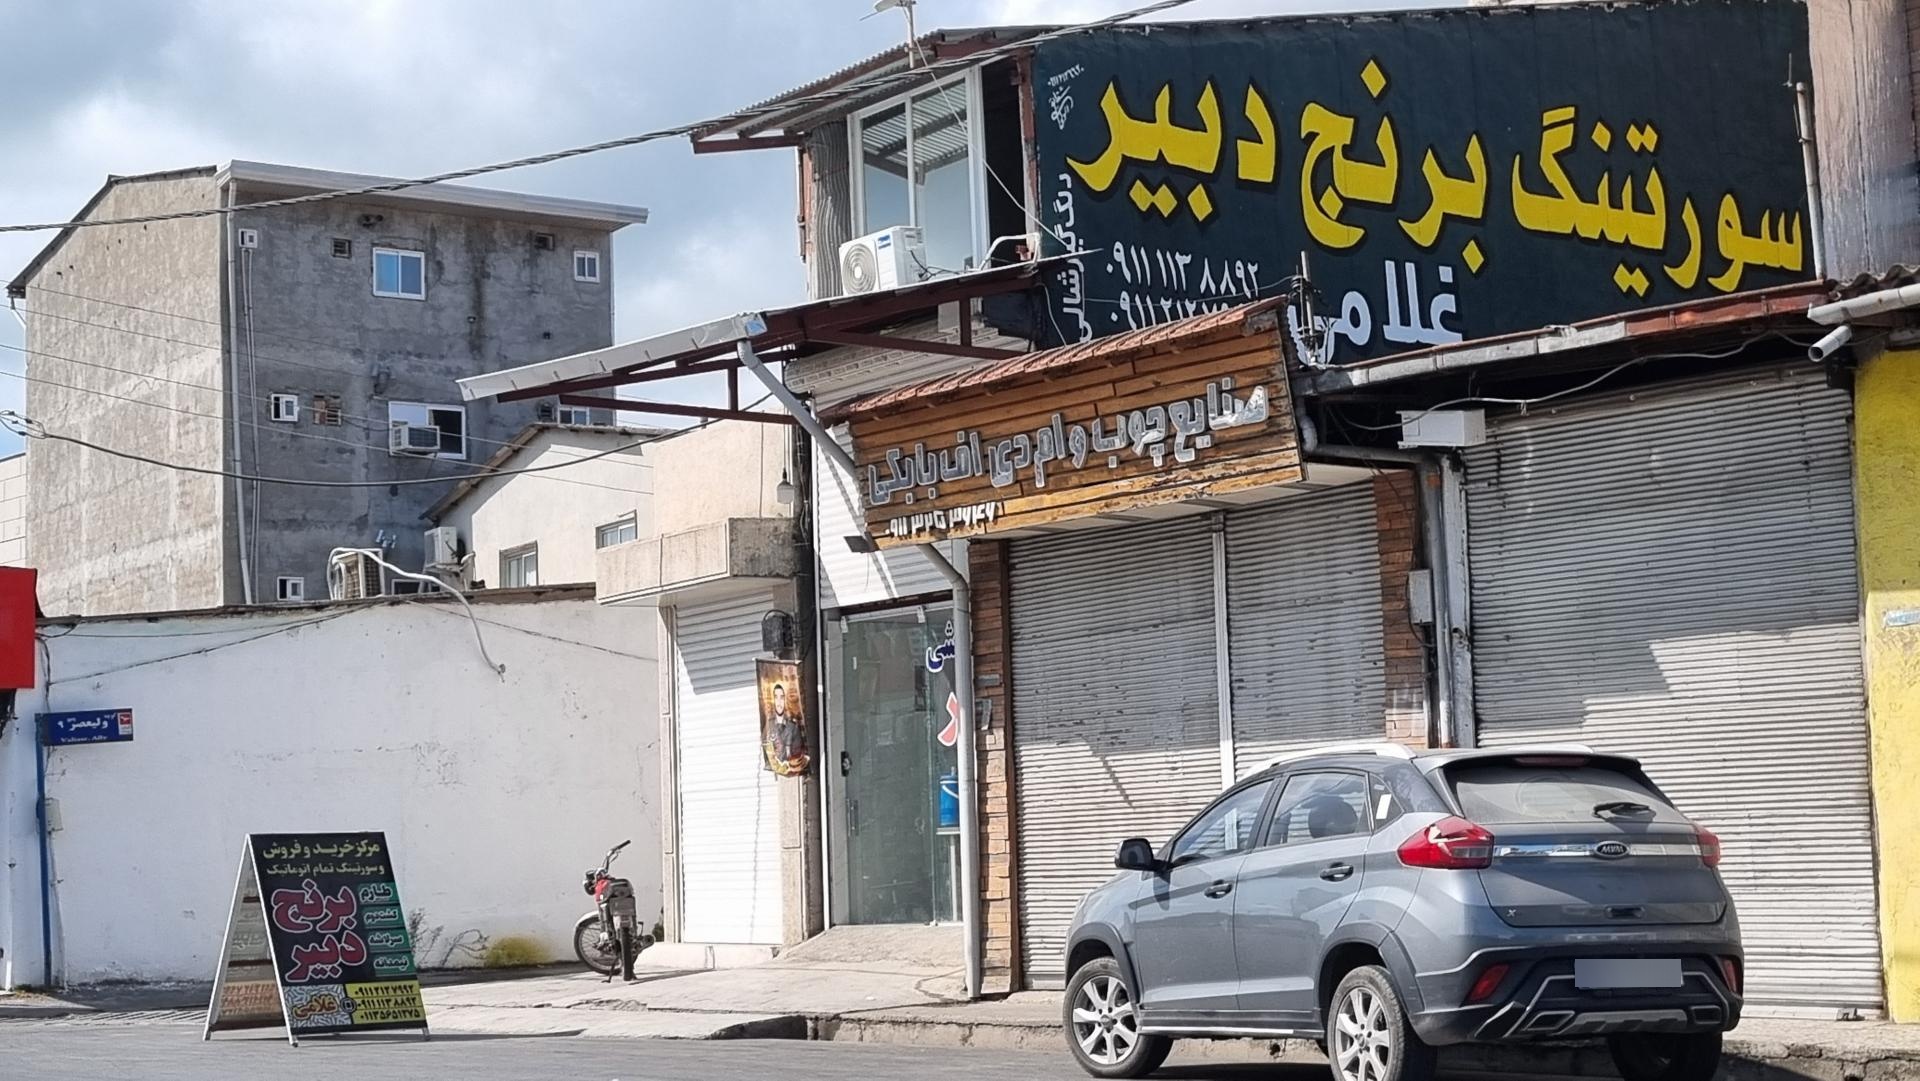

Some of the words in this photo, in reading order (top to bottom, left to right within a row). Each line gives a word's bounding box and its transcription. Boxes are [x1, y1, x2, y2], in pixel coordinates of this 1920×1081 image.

[1066, 80, 1277, 220] دبیر
[1299, 59, 1487, 274] برنج
[1511, 106, 1802, 294] سورتینگ
[1092, 406, 1166, 469] چوب
[1168, 376, 1269, 463] صنایع
[940, 430, 984, 482] اف
[988, 433, 1031, 488] دی
[1034, 412, 1067, 489] ام
[1068, 425, 1088, 470] و
[263, 839, 301, 859] فروش
[303, 845, 311, 858] و
[313, 839, 354, 857] خرید
[313, 862, 334, 876] تمام
[354, 839, 380, 857] مرکز
[271, 878, 357, 934] برنج
[359, 883, 393, 903] طارم
[285, 930, 367, 983] دبیر
[292, 993, 338, 1019] غلامی
